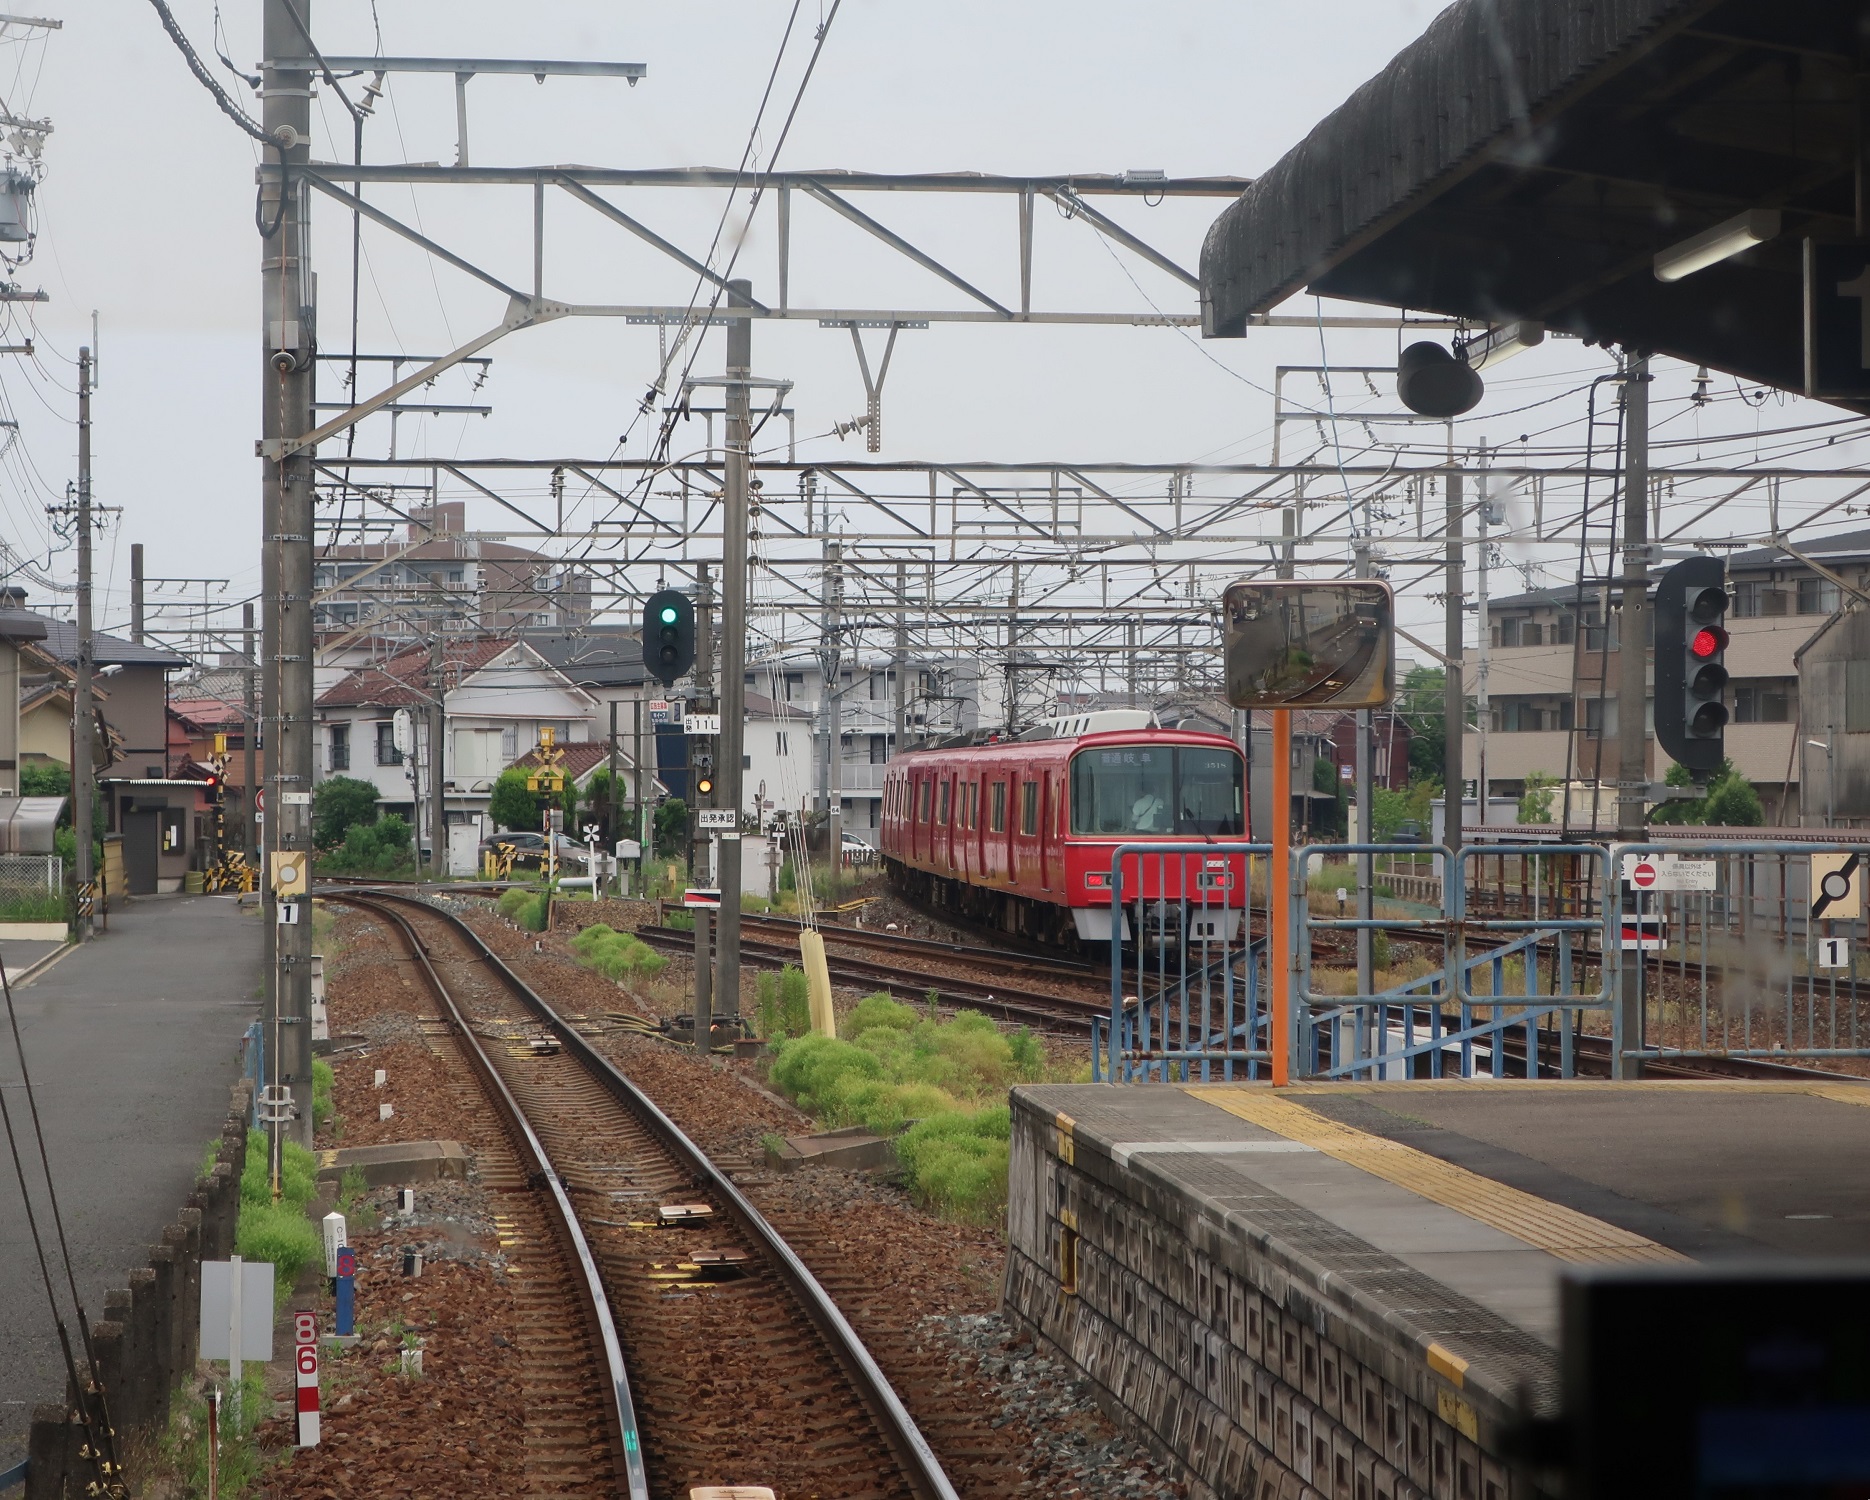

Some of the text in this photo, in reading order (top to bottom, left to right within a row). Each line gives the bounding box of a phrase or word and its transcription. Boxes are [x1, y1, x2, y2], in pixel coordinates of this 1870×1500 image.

[685, 718, 692, 732] 出発
[695, 720, 719, 730] 11L
[700, 813, 735, 824] 出発承認
[773, 822, 785, 832] 70
[283, 905, 292, 923] 1
[1826, 940, 1838, 966] 1
[337, 1254, 355, 1277] 8
